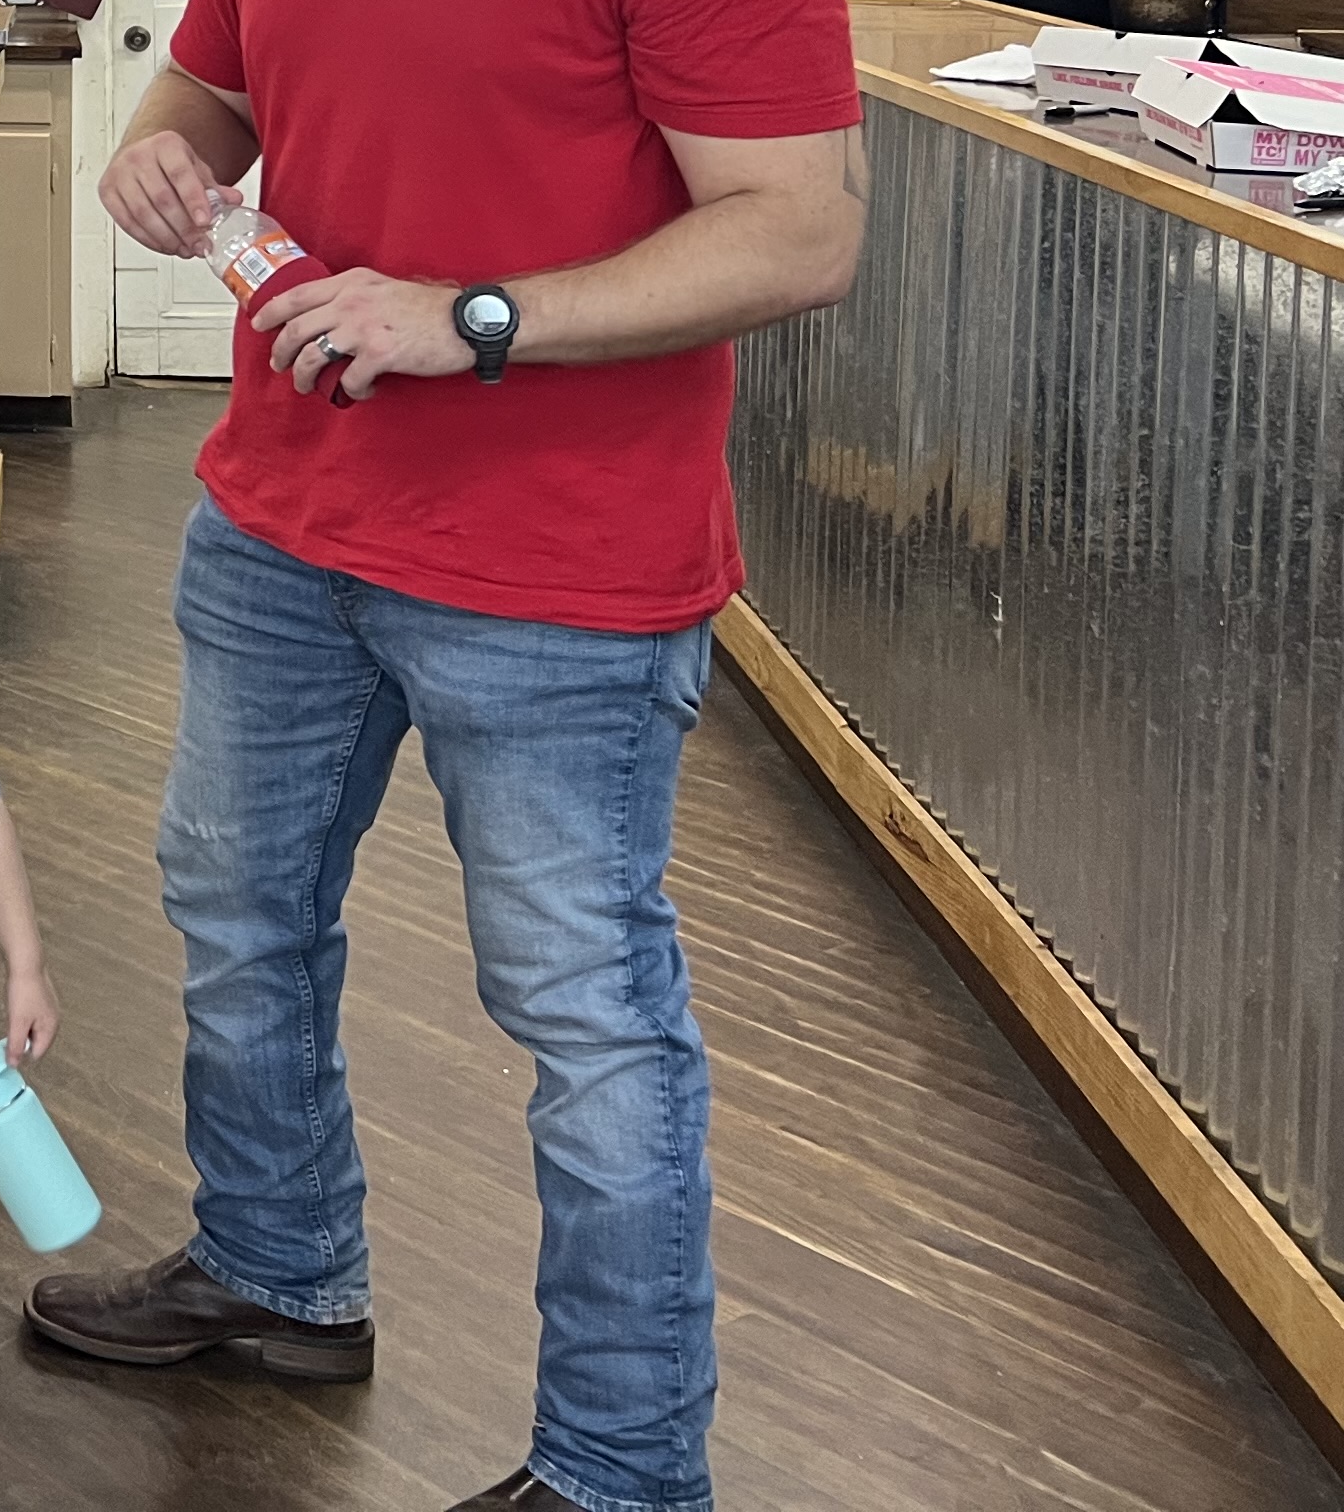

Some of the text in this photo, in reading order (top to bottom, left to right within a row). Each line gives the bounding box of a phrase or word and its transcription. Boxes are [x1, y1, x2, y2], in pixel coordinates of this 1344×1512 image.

[1256, 132, 1286, 145] MY
[1255, 145, 1283, 158] TC!
[1294, 149, 1321, 167] MY
